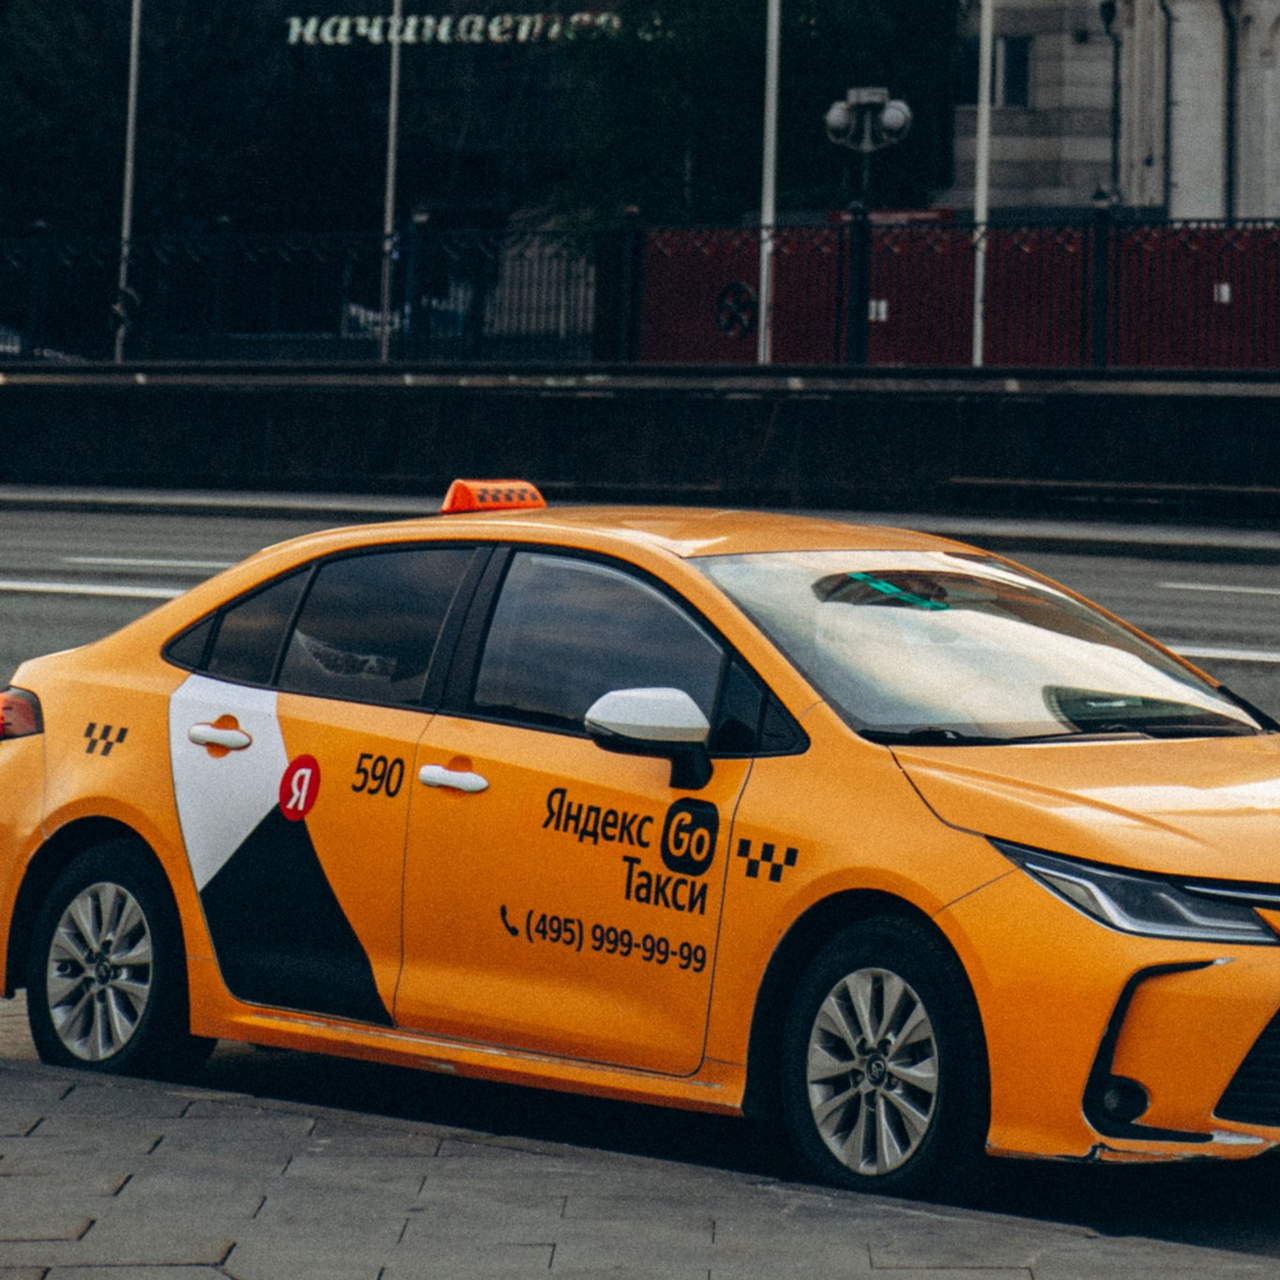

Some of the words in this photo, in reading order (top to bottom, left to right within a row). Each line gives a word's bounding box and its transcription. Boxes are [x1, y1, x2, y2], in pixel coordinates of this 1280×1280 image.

[286, 767, 313, 811] Я
[351, 752, 405, 798] 590
[542, 787, 654, 849] Яндекс
[667, 811, 711, 862] Go
[622, 855, 708, 916] Такси
[525, 909, 584, 952] (495)
[591, 923, 707, 973] 999-99-99
